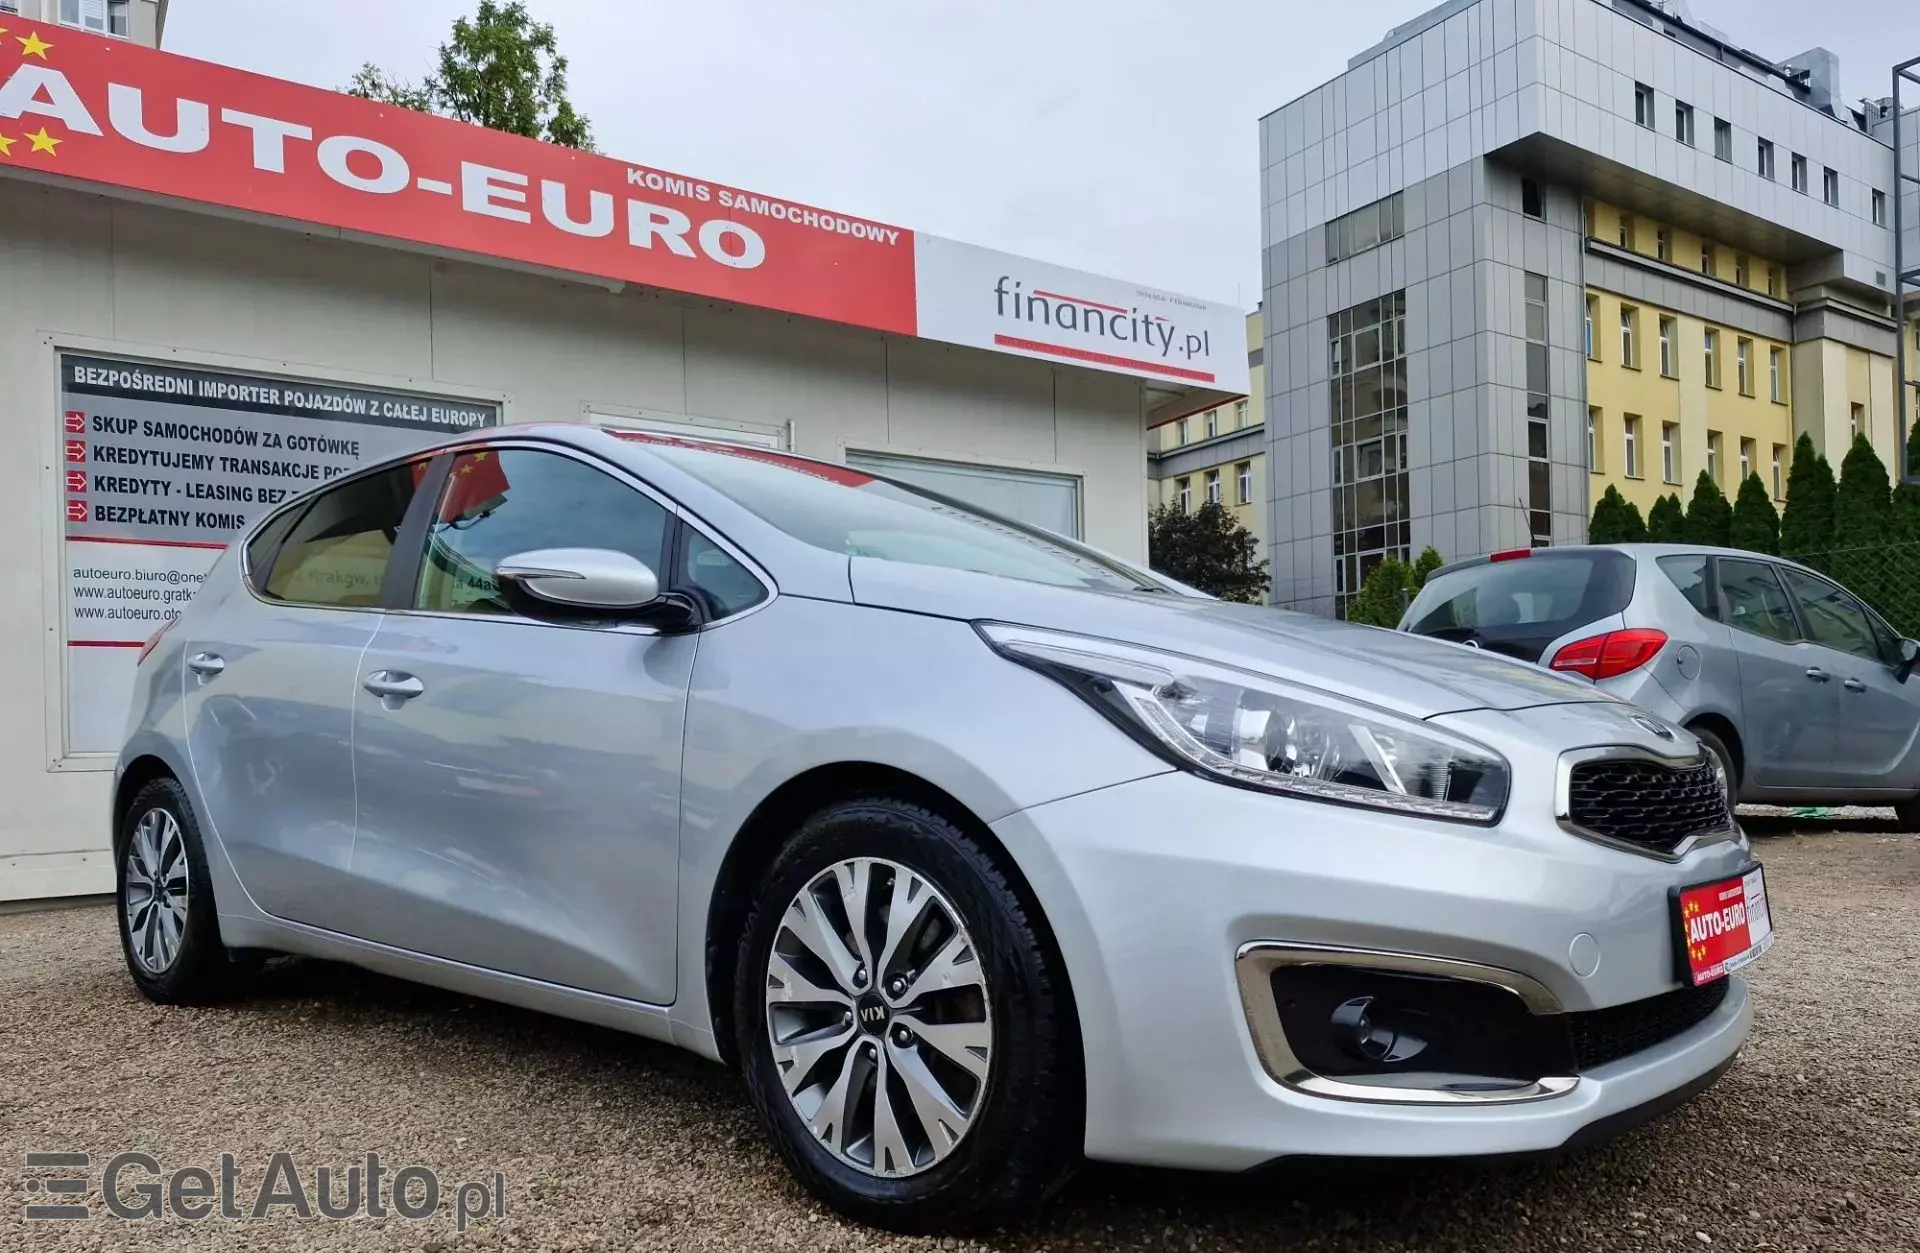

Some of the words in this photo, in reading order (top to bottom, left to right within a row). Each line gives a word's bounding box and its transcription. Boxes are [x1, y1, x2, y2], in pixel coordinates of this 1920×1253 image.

[0, 63, 766, 269] AUTO-EURO
[627, 167, 710, 202] KOMIS
[718, 185, 900, 246] SAMOCHODOWY
[993, 276, 1210, 360] financity.pl
[74, 366, 194, 396] BEZPOŚREDNI
[199, 380, 280, 405] IMPORTER
[284, 390, 367, 414] POJAZDÓW
[369, 401, 380, 417] Z
[383, 402, 427, 422] CAŁEJ
[431, 407, 487, 428] EUROPY
[92, 415, 138, 435] SKUP
[143, 420, 258, 447] SAMOCHODÓW
[262, 433, 283, 450] ZA
[287, 434, 360, 461] GOTÓWKĘ
[93, 445, 215, 471] KREDYTUJEMY
[219, 456, 320, 480] TRANSAKCJE
[94, 475, 172, 497] KREDYTY
[186, 482, 253, 502] LEASING
[258, 488, 287, 504] BEZ
[95, 504, 191, 528] BEZPŁATNY
[195, 512, 246, 530] KOMIS
[1690, 902, 1746, 943] AUTO-EURO
[860, 1005, 886, 1022] KIA
